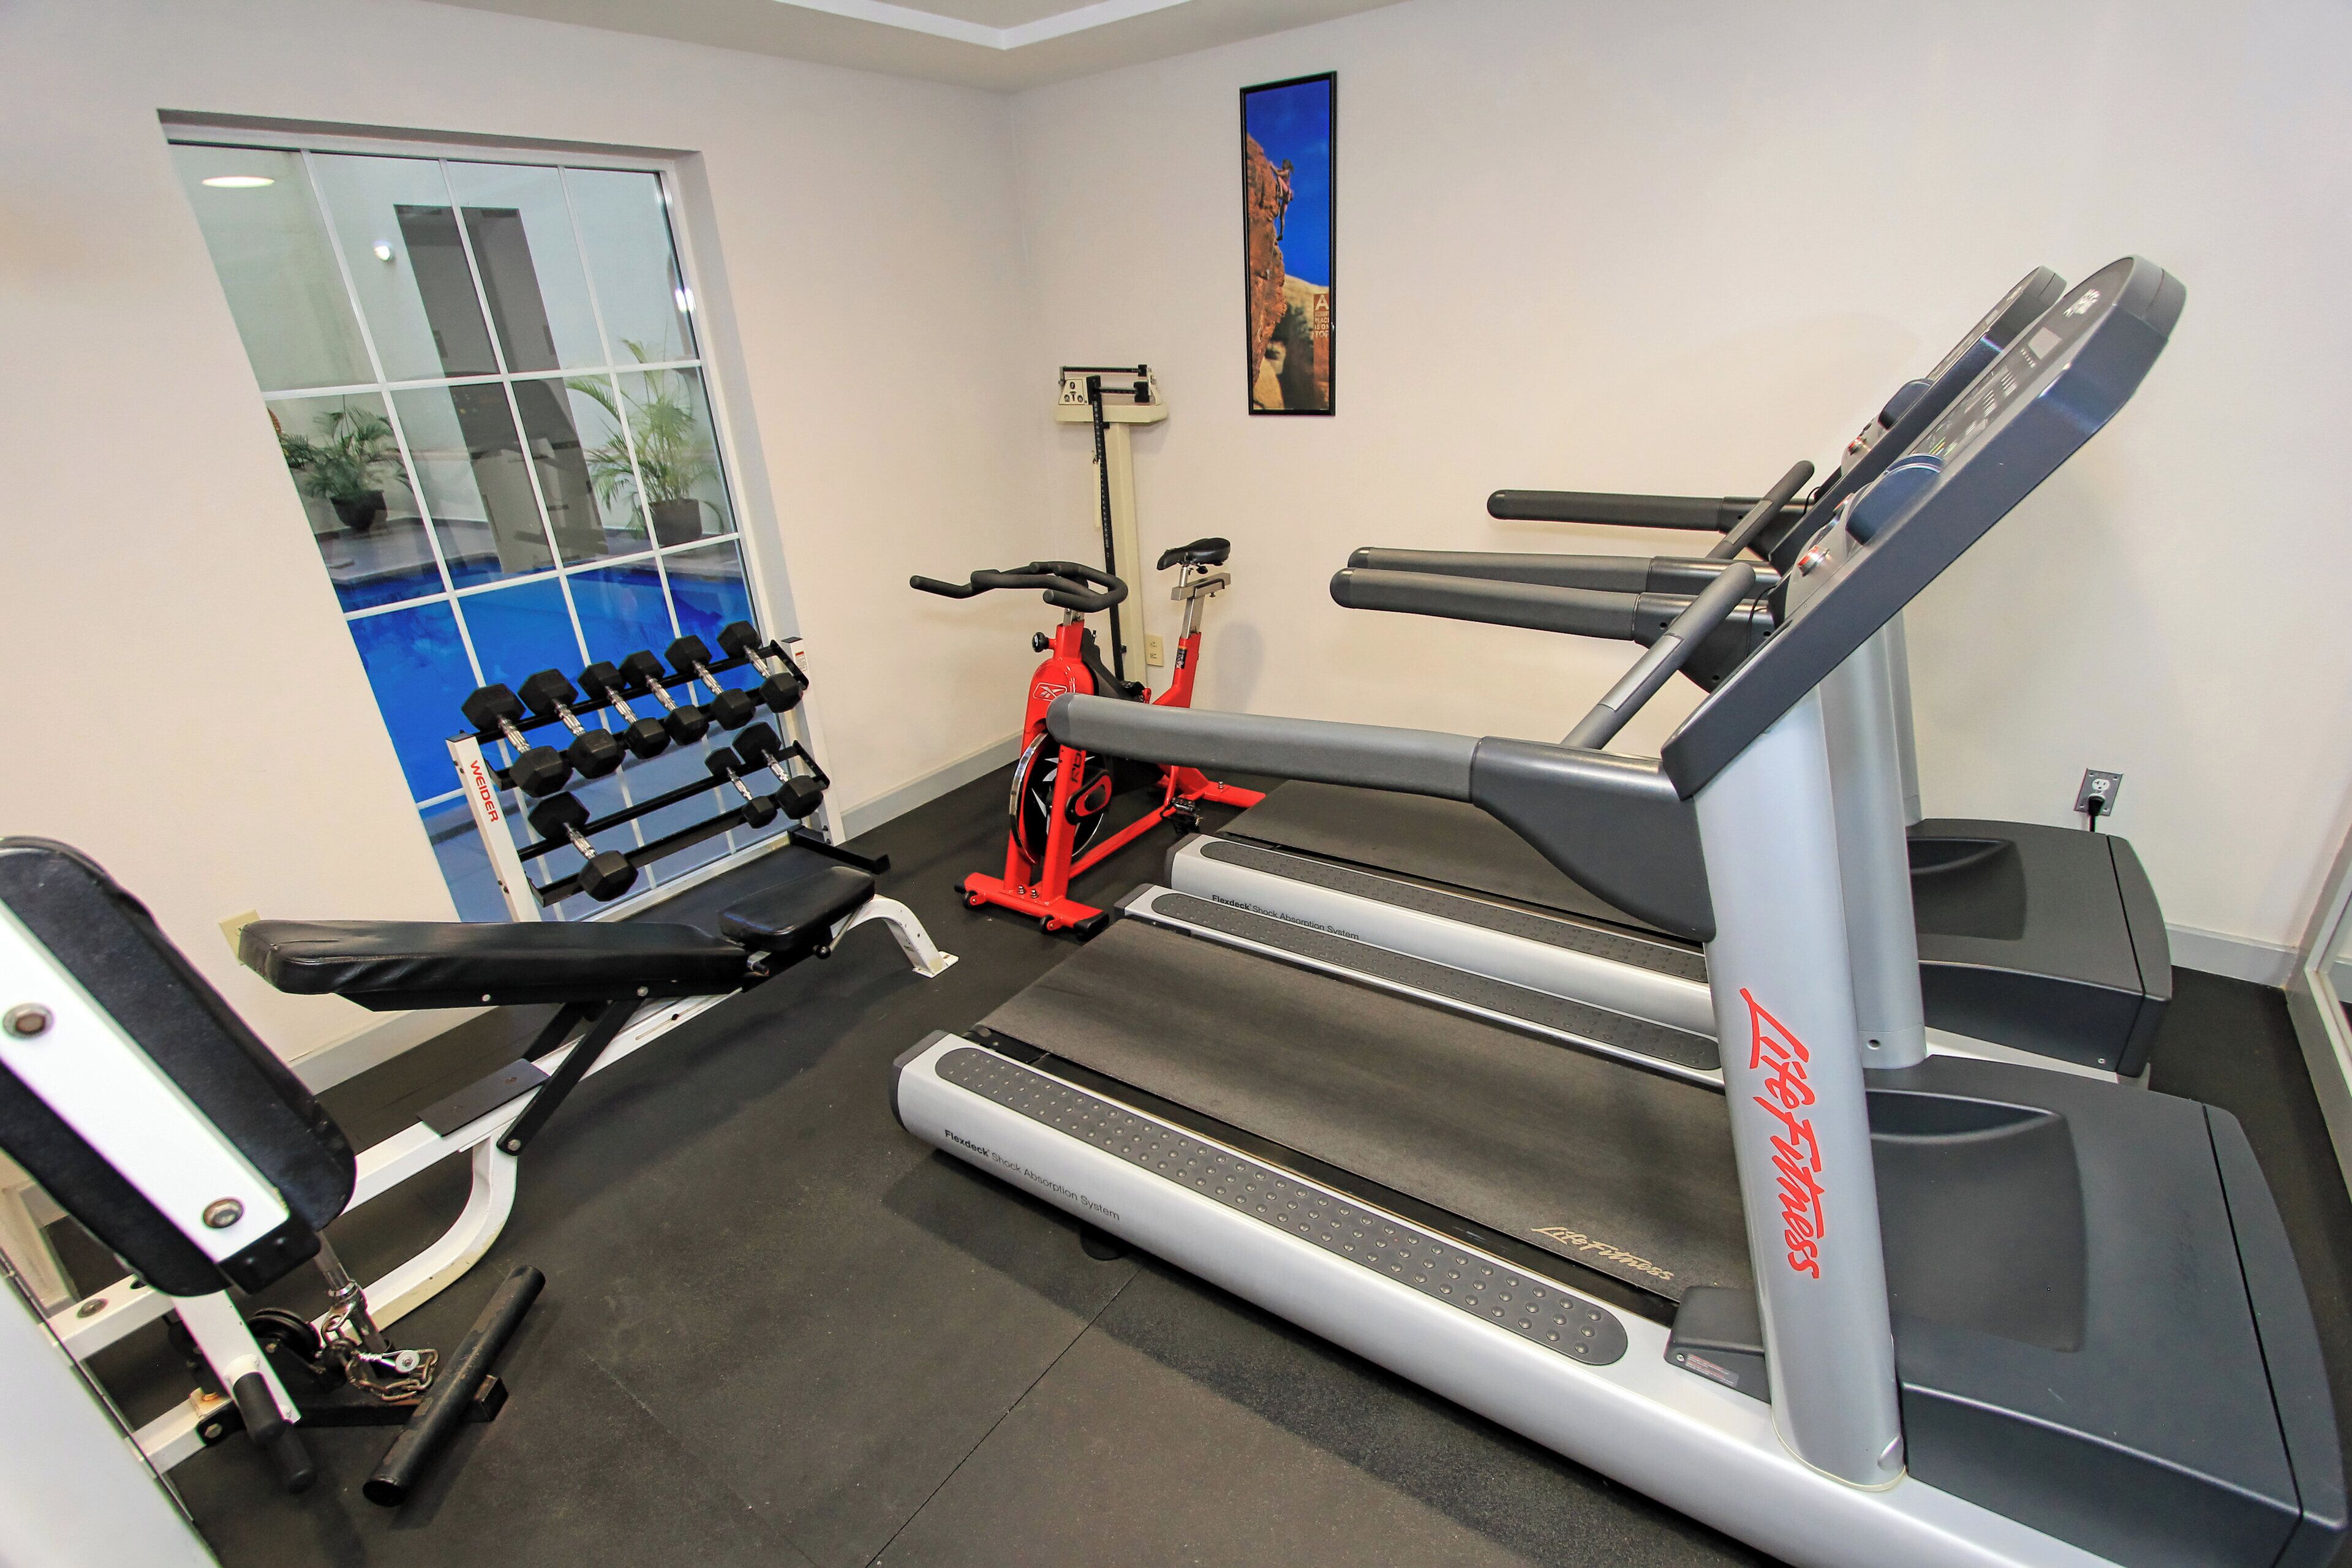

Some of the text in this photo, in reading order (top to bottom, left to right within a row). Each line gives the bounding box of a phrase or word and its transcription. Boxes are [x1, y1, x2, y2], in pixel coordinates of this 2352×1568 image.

[1315, 294, 1329, 311] A
[470, 760, 499, 822] WEIDER
[1212, 894, 1359, 941] Flexdeck Shock Absorption System
[944, 1129, 1120, 1221] Flexdeck Shock Absorption System
